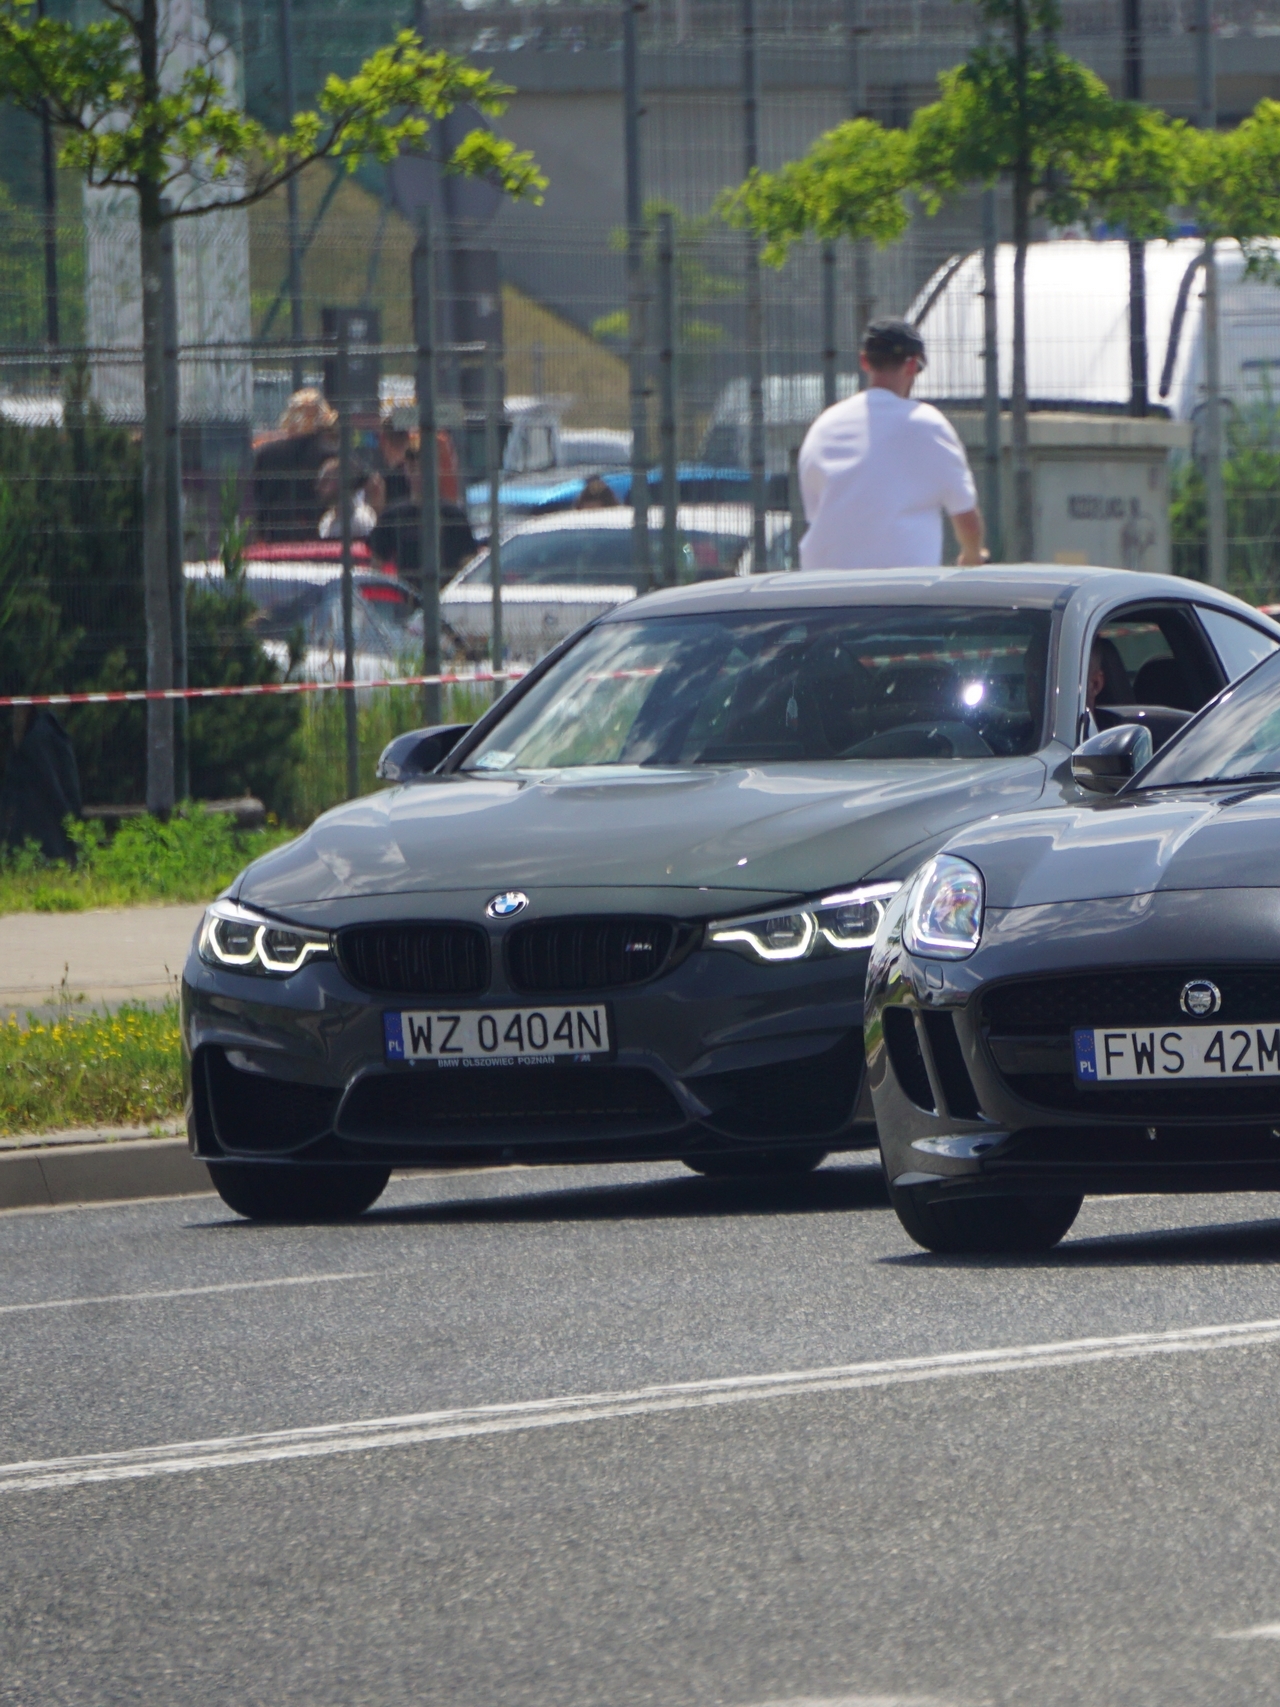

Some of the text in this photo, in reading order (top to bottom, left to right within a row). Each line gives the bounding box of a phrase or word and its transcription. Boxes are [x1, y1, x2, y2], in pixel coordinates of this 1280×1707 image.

[388, 1010, 602, 1054] PL WZ 0404N
[1080, 1061, 1094, 1073] PL
[1104, 1032, 1185, 1075] FWS
[437, 1059, 460, 1068] BMW
[462, 1057, 515, 1067] OLSZOWIEC
